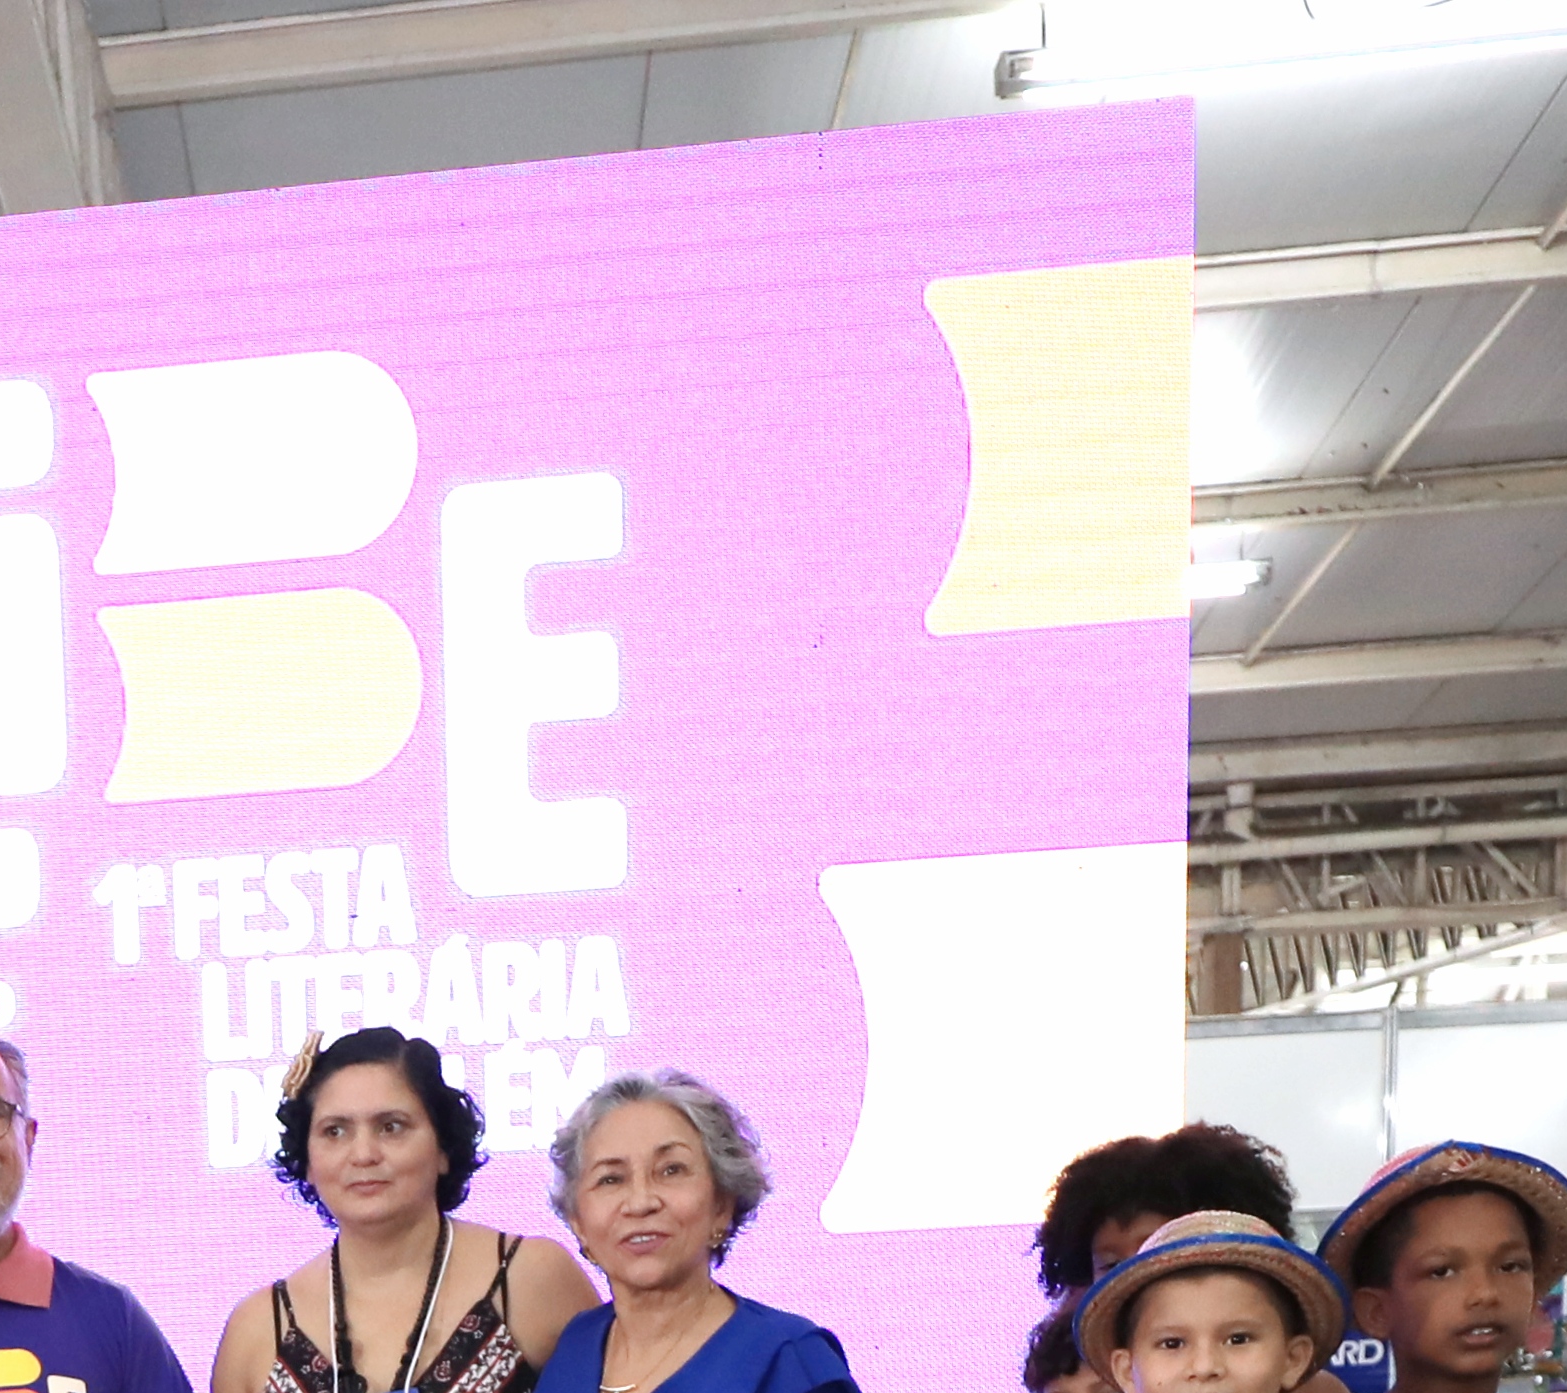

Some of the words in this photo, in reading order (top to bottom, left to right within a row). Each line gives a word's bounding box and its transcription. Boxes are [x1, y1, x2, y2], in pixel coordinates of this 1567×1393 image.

[172, 844, 418, 961] FESTA
[201, 933, 632, 1062] LITERÁRIA
[1330, 1338, 1385, 1367] RD
